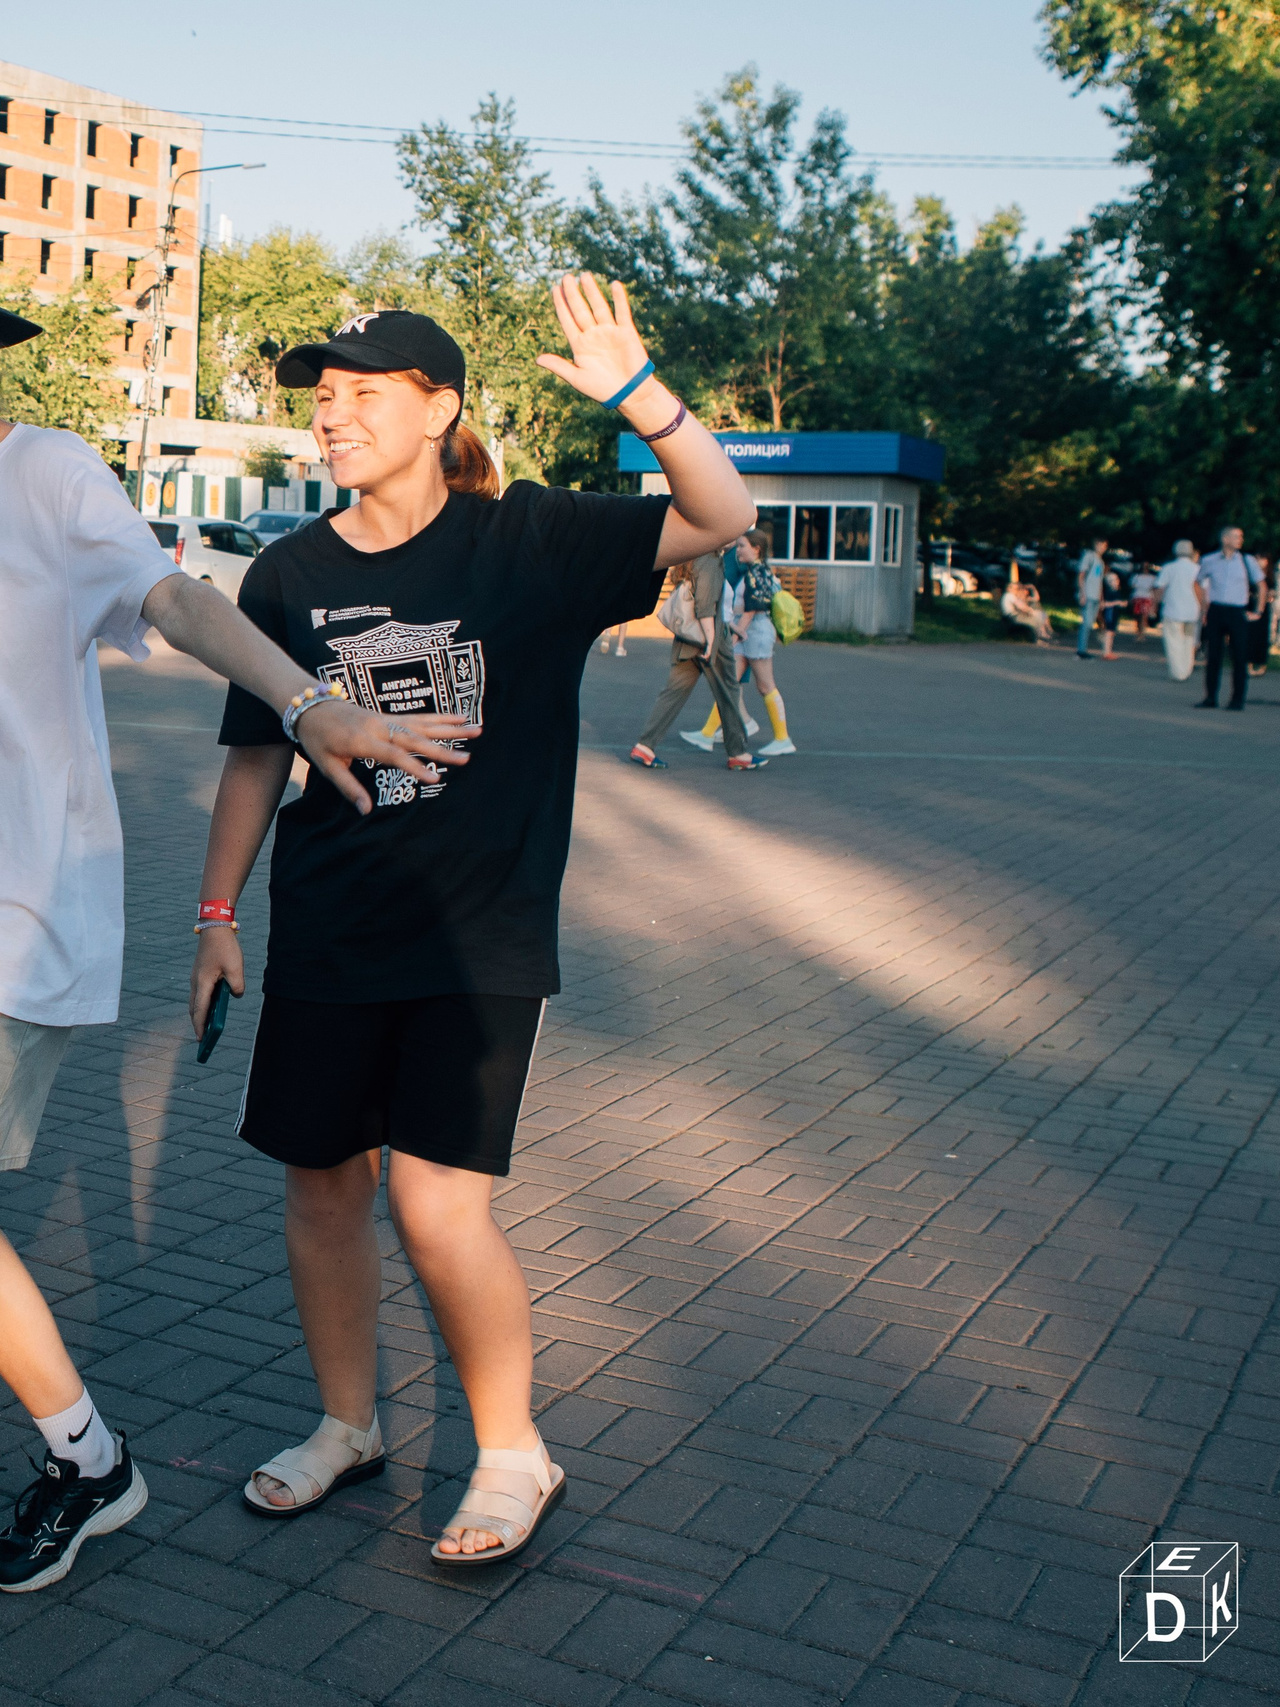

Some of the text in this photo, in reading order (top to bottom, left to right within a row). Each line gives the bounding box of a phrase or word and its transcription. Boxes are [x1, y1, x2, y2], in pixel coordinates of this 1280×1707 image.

[724, 443, 790, 458] ПОЛИЦИЯ
[377, 686, 433, 702] ОКНО В МИР
[389, 699, 426, 713] ДЖАЗА
